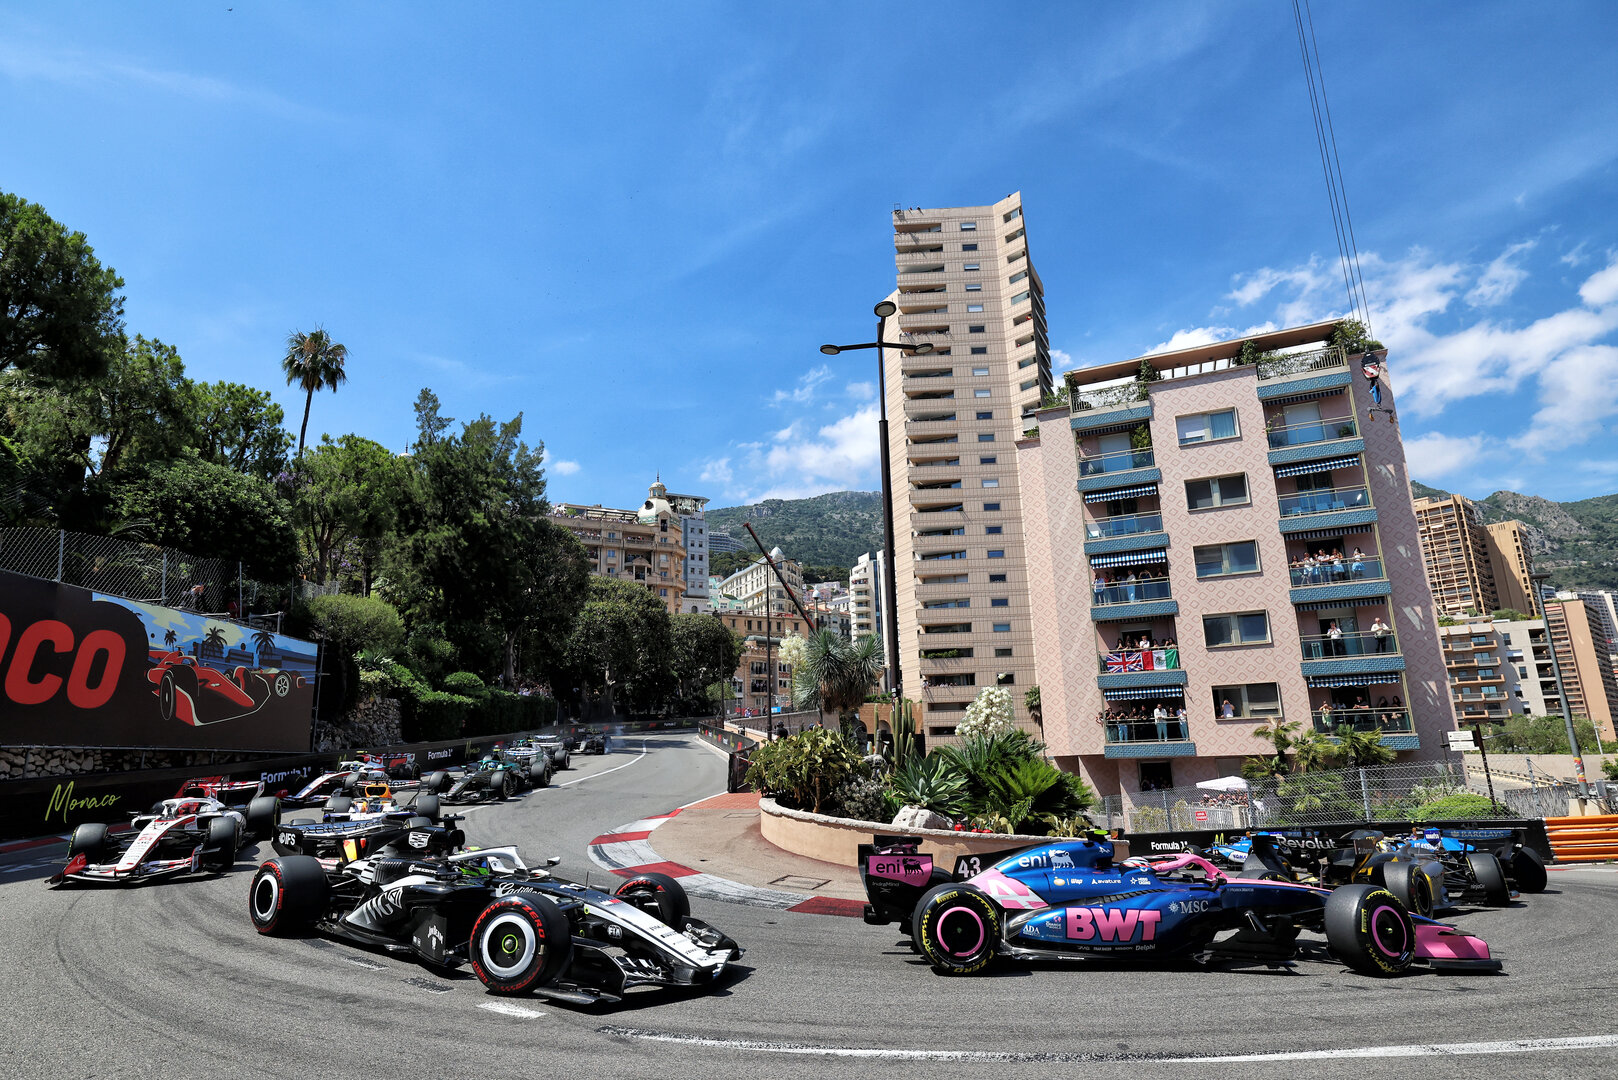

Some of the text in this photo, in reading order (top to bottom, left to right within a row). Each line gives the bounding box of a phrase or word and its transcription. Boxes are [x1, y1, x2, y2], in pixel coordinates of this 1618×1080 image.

[0, 612, 126, 709] CO
[428, 750, 449, 760] Formula
[45, 780, 121, 823] Monaco
[284, 833, 296, 846] IFS
[1460, 829, 1504, 838] BARCLAYS
[1150, 841, 1180, 850] Formula
[1276, 836, 1337, 850] Revolut
[876, 859, 900, 874] eni
[1018, 852, 1047, 868] eni
[957, 857, 981, 878] 43
[936, 891, 958, 904] PIRELLI
[1180, 900, 1209, 914] MSC
[522, 904, 546, 939] ZERO
[1066, 907, 1162, 942] BWT
[608, 927, 620, 938] FIA
[1022, 924, 1040, 934] ADA
[1135, 943, 1156, 951] Delphi
